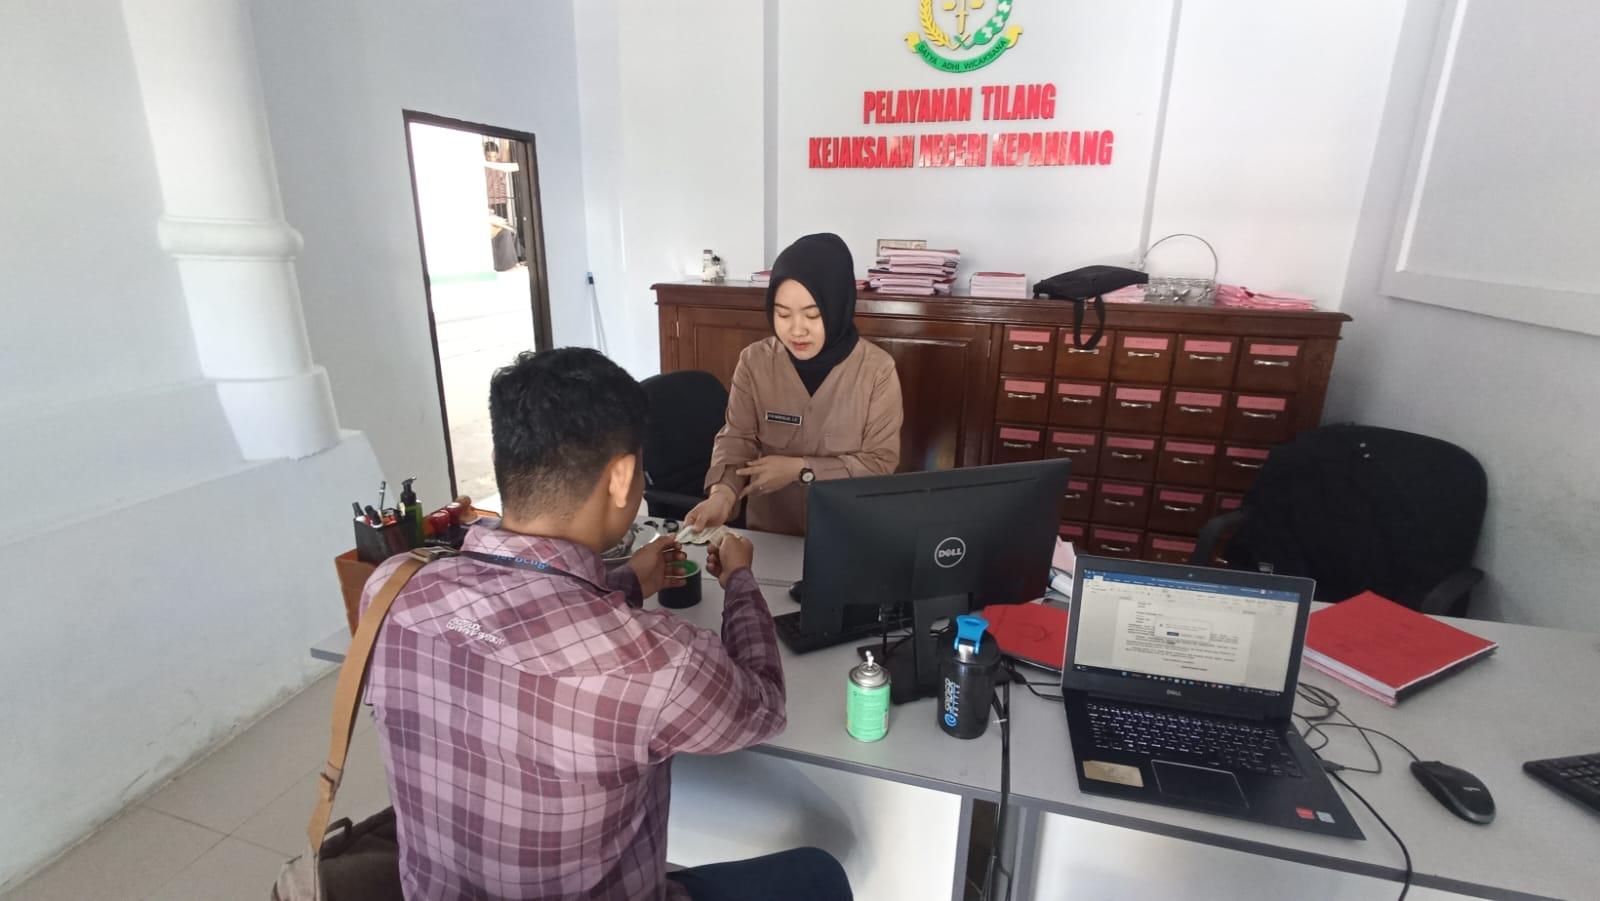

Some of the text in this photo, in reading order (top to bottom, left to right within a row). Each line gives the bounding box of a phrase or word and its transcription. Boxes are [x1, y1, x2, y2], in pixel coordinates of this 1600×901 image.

[918, 40, 1007, 71] SATYA ADHI WICAKSANA
[863, 83, 1057, 124] PELAYANAN TILANG
[808, 130, 1115, 169] KEJAKSAAN NEGERI KEPAHIANG
[938, 547, 962, 559] DELL
